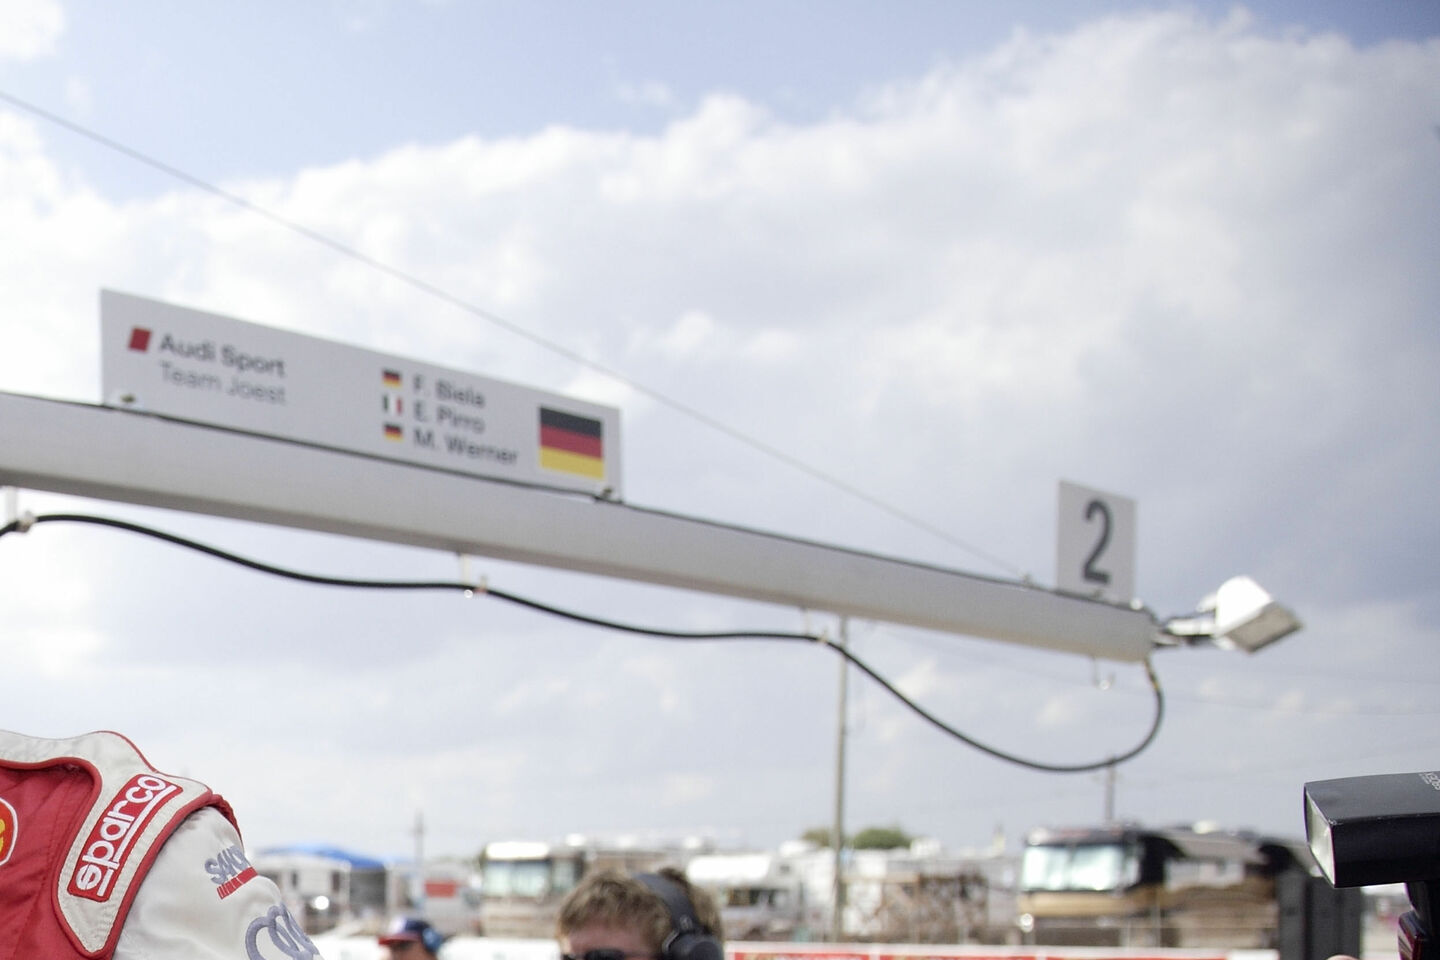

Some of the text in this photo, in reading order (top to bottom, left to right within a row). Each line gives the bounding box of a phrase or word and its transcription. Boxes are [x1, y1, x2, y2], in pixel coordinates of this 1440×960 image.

[160, 334, 286, 378] Audi Sport
[1083, 500, 1112, 585] 2
[75, 775, 167, 891] sparco
